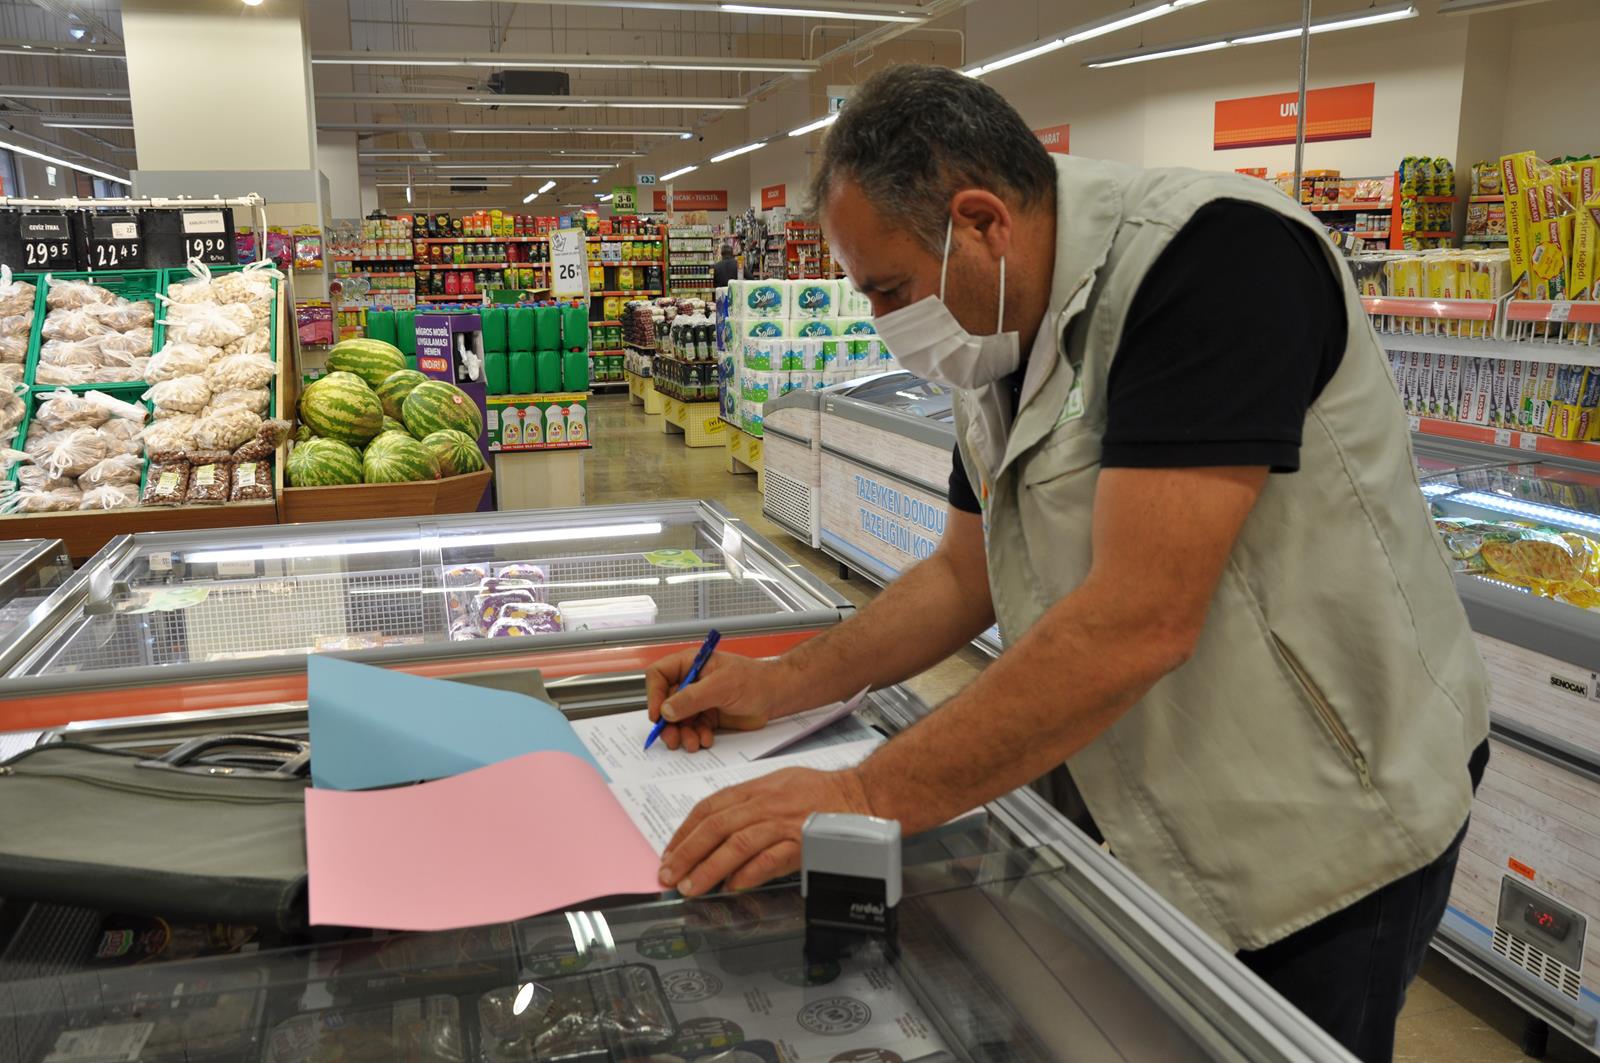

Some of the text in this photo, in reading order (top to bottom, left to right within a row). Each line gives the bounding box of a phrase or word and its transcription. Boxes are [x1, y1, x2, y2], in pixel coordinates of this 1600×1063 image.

[1280, 102, 1299, 117] UN
[1509, 200, 1520, 236] Pişirme
[1462, 393, 1471, 419] COOK
[1476, 395, 1485, 420] COOK
[854, 474, 947, 536] TAZEYKEN DONDU
